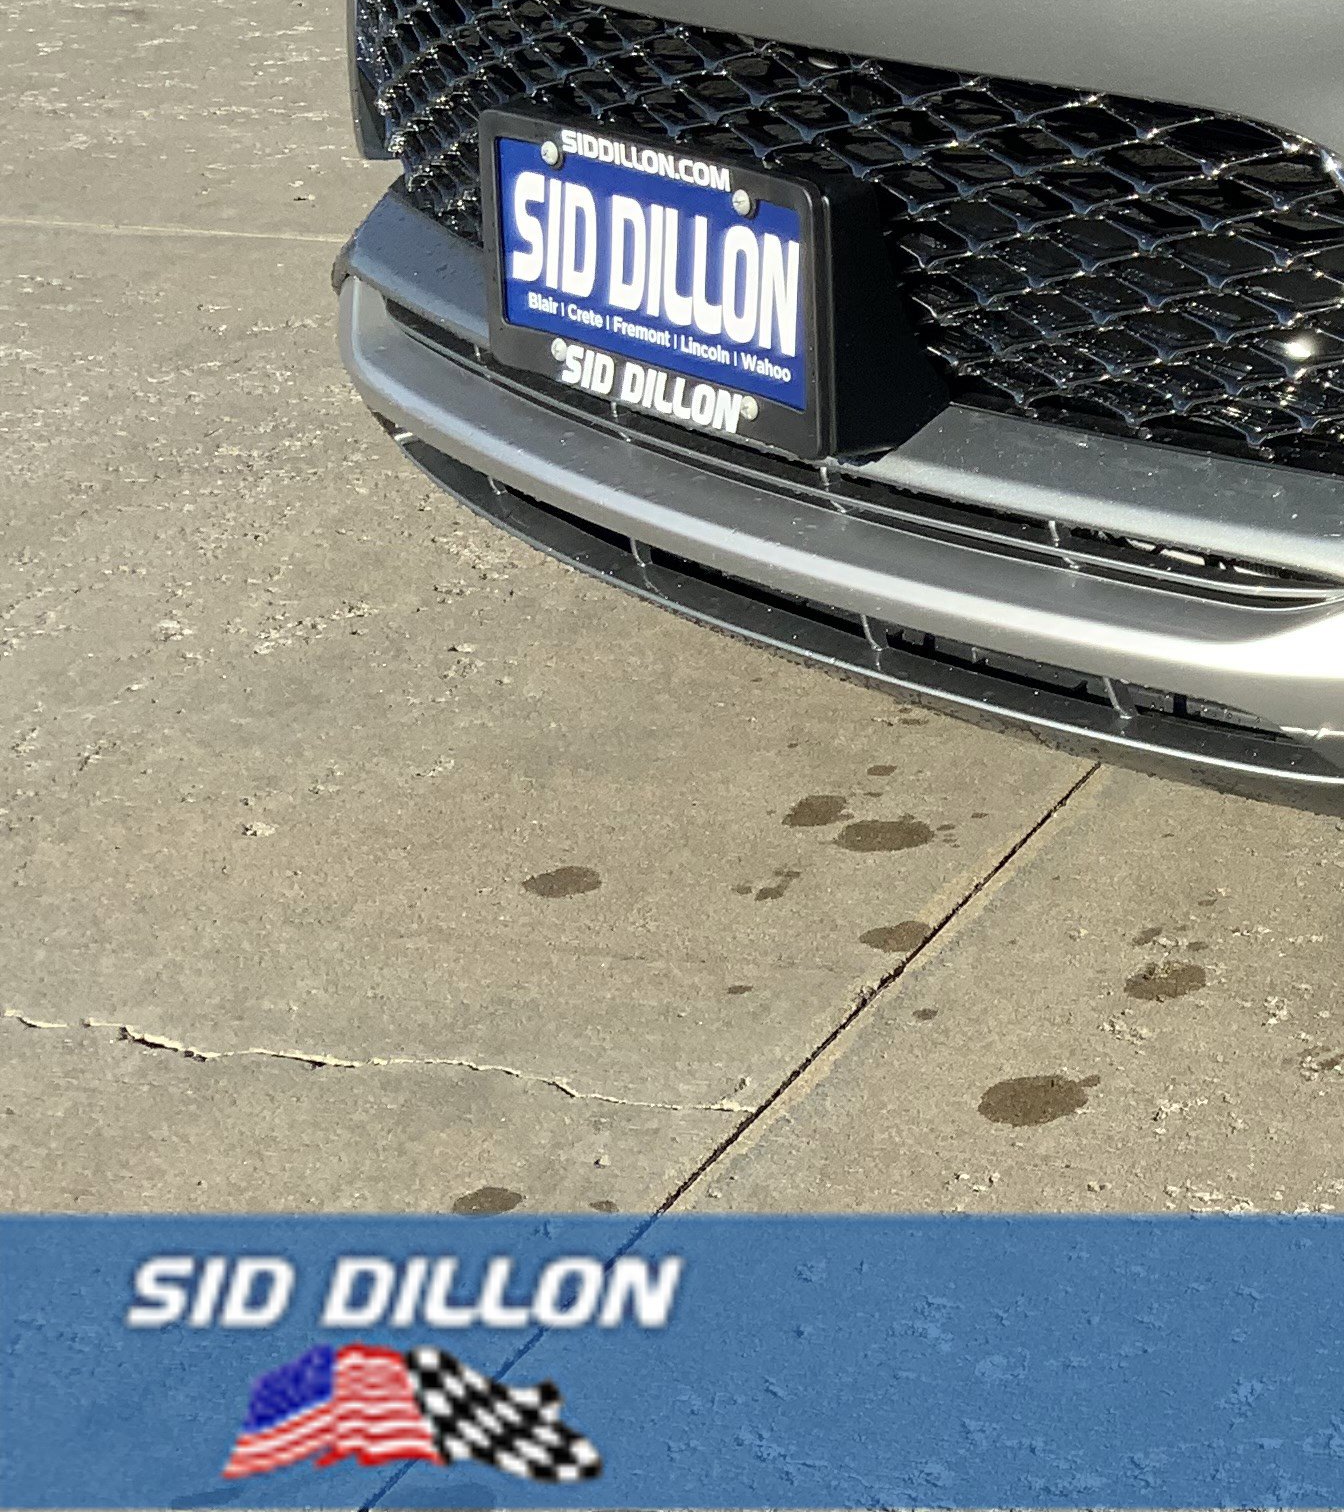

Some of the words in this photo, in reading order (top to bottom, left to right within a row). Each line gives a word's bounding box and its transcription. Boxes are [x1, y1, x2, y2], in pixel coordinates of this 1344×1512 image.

[561, 129, 731, 193] SIDDILLON.COM
[512, 171, 598, 298] SID
[608, 194, 800, 357] DILLON
[528, 292, 559, 316] Blair
[567, 303, 603, 329] Crete
[613, 316, 671, 349] Fremont
[680, 334, 730, 366] Lincoln
[740, 351, 792, 383] Wahoo
[561, 344, 615, 395] SID
[621, 360, 742, 434] DILLON
